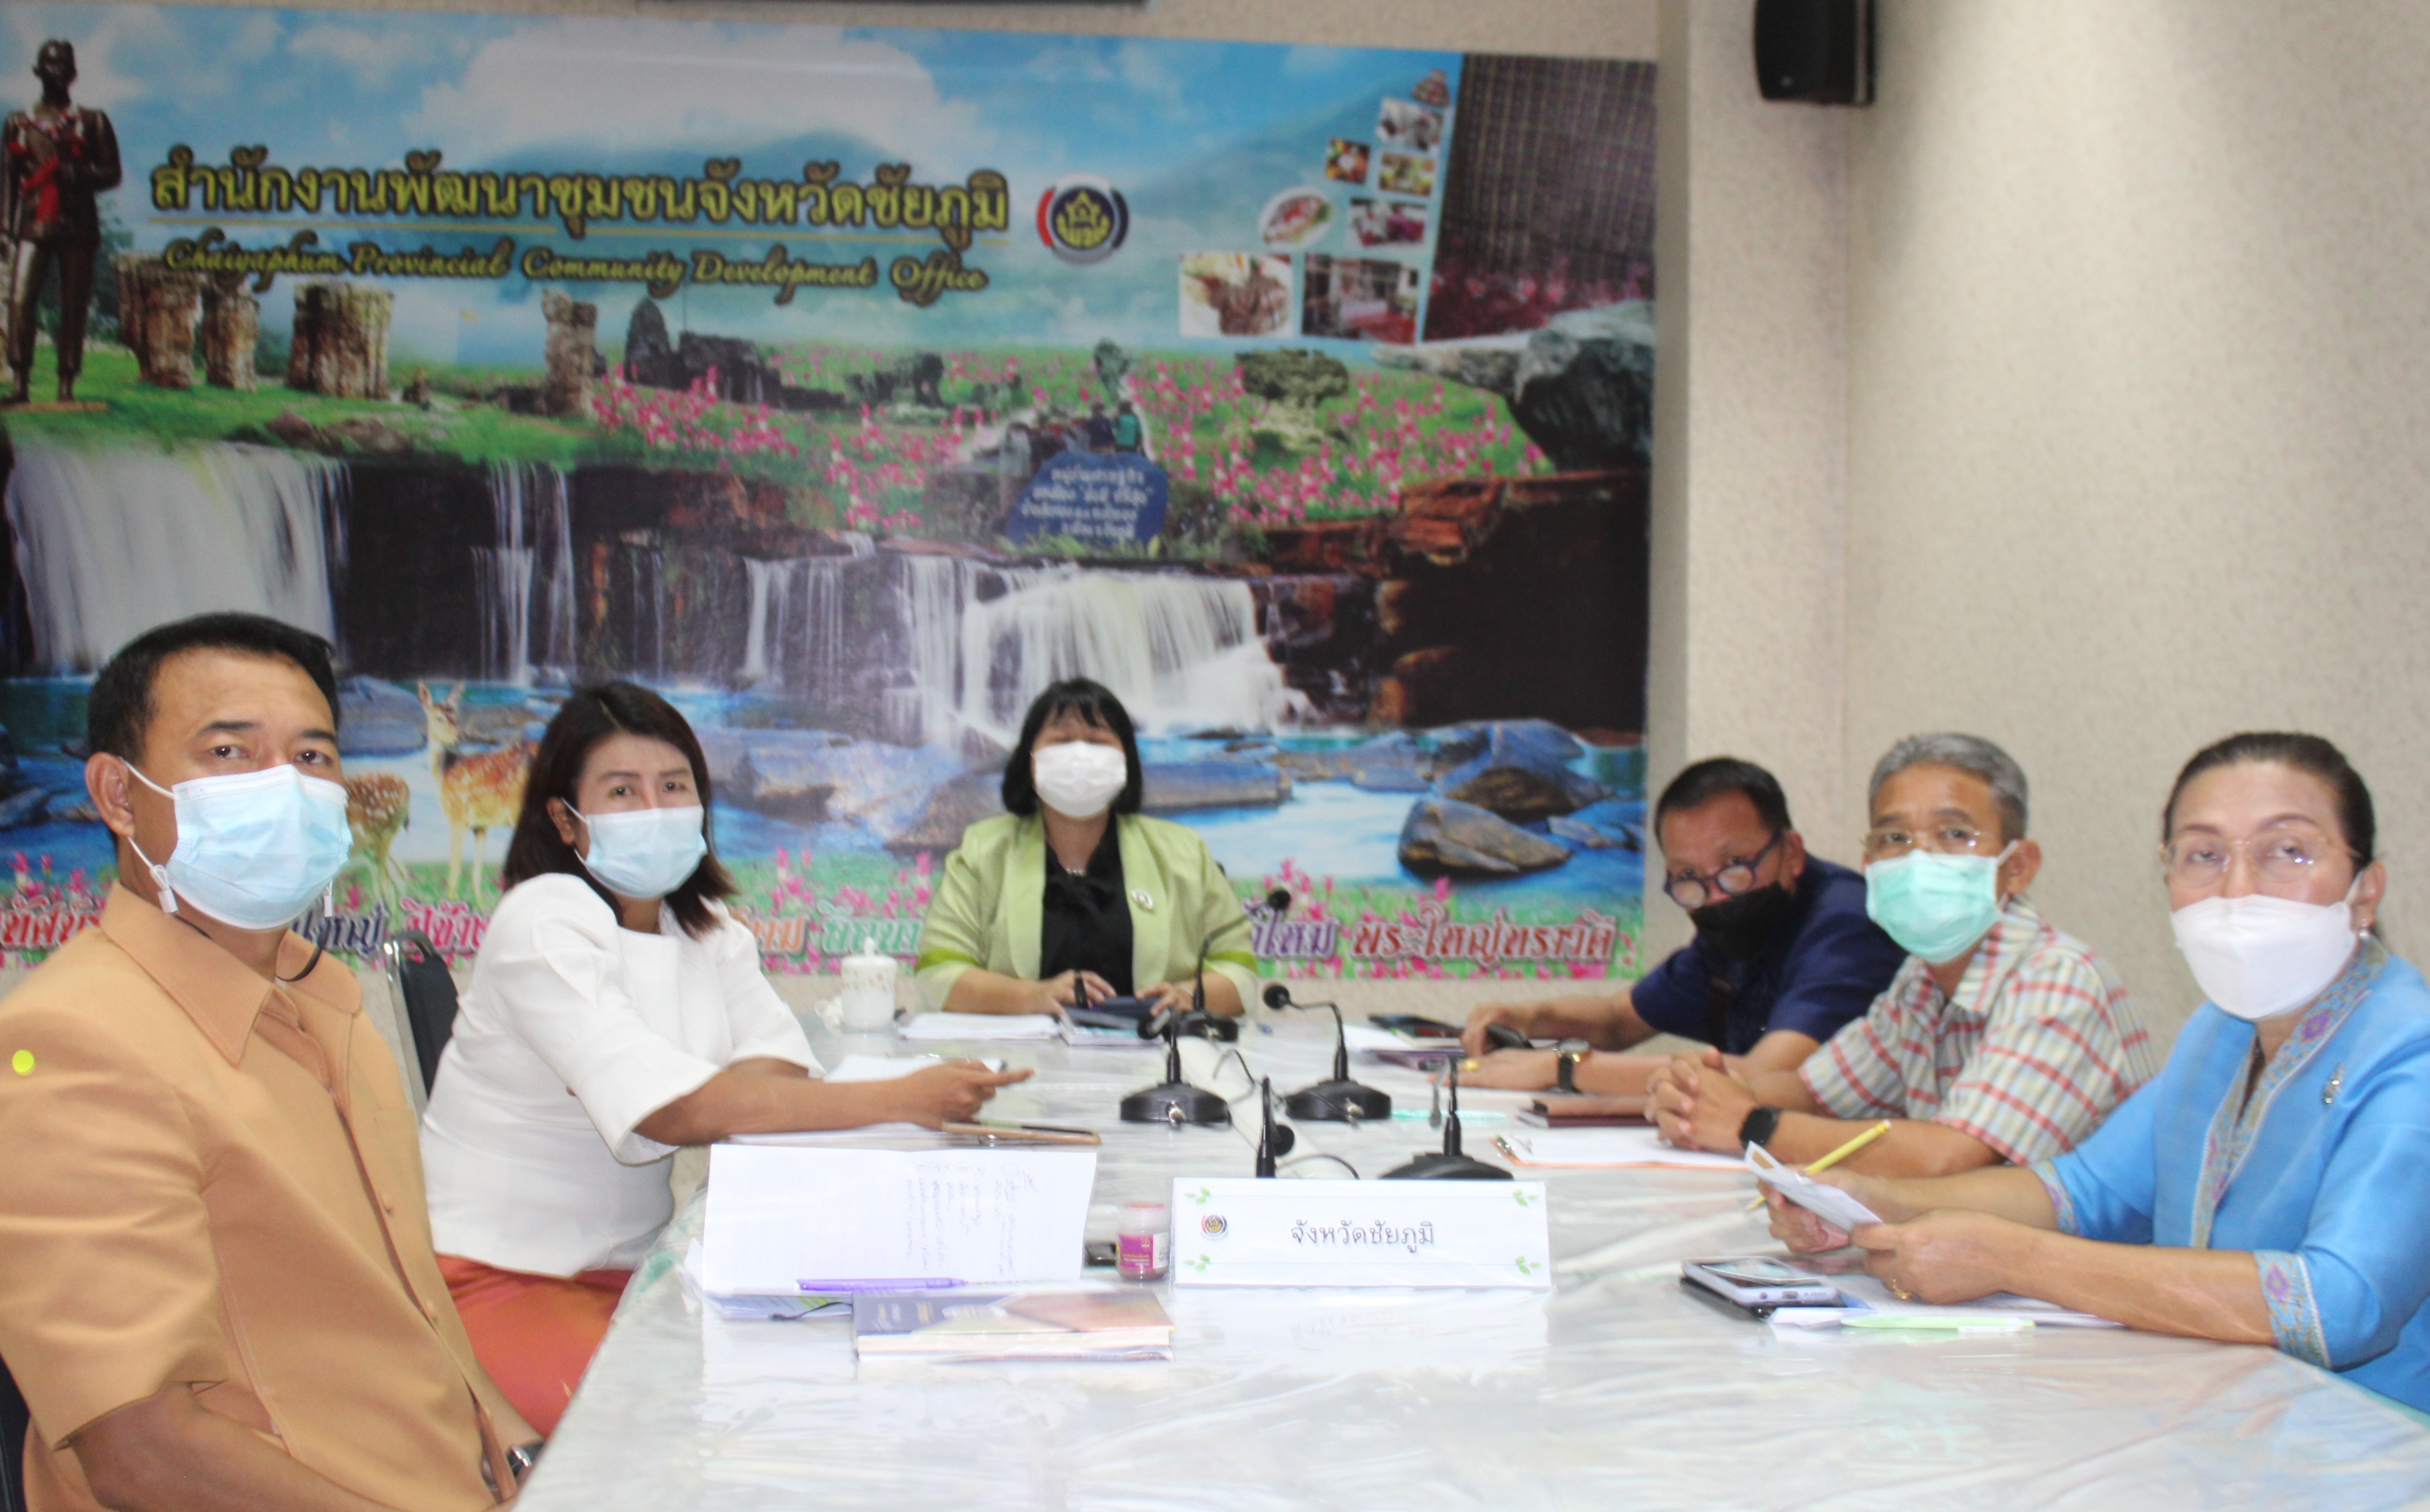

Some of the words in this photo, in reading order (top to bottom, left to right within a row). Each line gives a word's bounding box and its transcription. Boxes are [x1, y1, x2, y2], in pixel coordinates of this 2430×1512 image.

[151, 143, 1010, 250] สำนักงานพัฒนาชุมชนจังหวัดชัยภูมิ
[348, 237, 515, 278] Provincial
[521, 246, 684, 298] Community
[690, 245, 878, 305] Development
[891, 246, 989, 307] Office
[1291, 1219, 1433, 1253] จังหวัดชัยภูมิ
